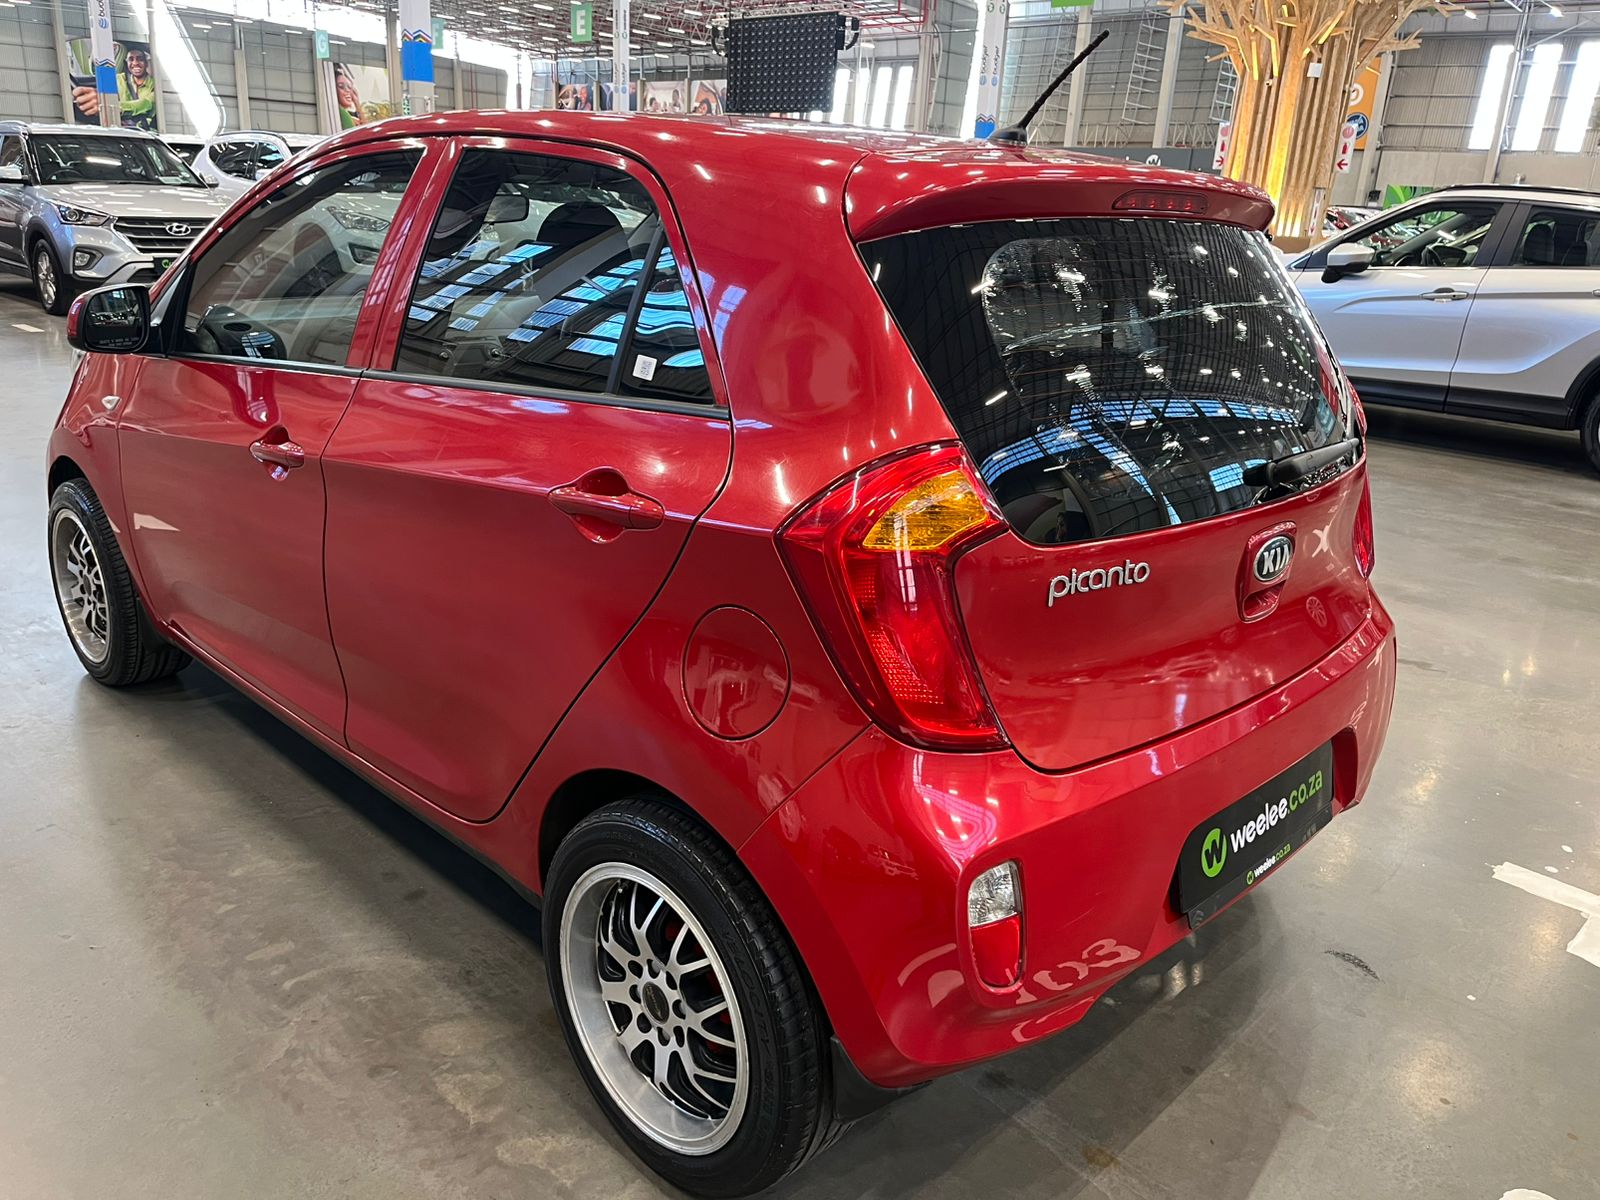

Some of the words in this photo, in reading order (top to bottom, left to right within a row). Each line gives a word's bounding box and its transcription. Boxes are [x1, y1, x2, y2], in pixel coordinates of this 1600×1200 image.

[576, 10, 586, 35] E
[317, 34, 326, 52] G
[1261, 544, 1291, 575] KIA
[1047, 559, 1151, 608] picanto
[1230, 769, 1323, 853] weelee.co.za
